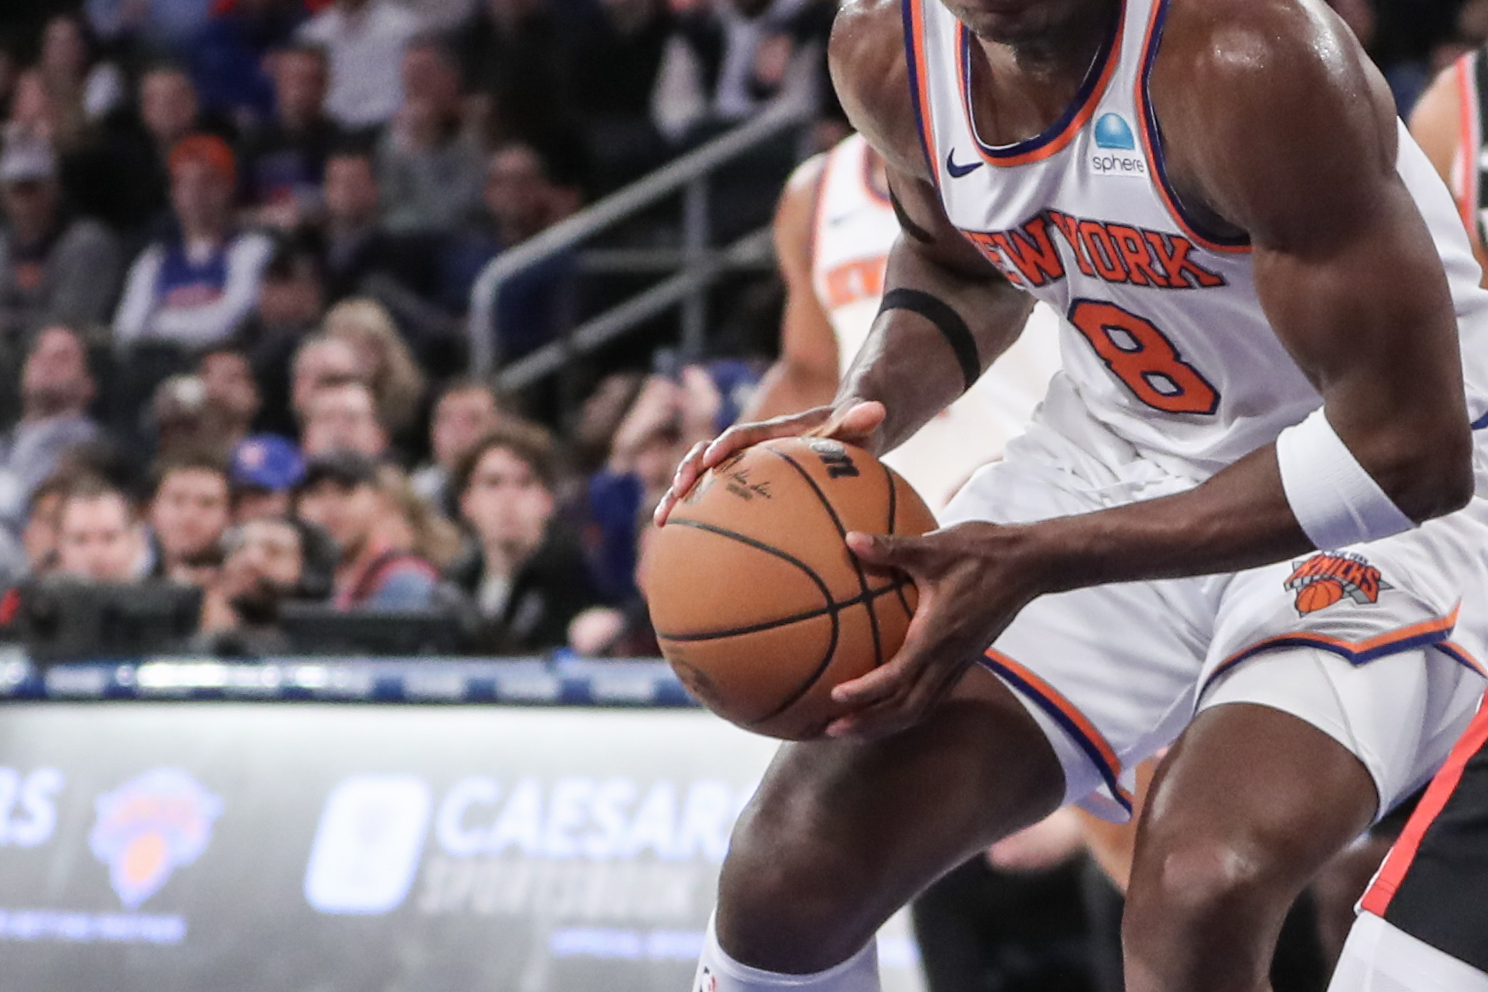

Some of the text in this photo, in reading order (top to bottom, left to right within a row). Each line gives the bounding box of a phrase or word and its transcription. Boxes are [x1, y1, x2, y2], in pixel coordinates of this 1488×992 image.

[1092, 155, 1145, 174] sphere
[961, 209, 1066, 287] EW
[1050, 210, 1226, 289] YORK
[1067, 297, 1221, 415] 8
[1283, 554, 1381, 604] KNICKS
[435, 775, 758, 862] CAESAR
